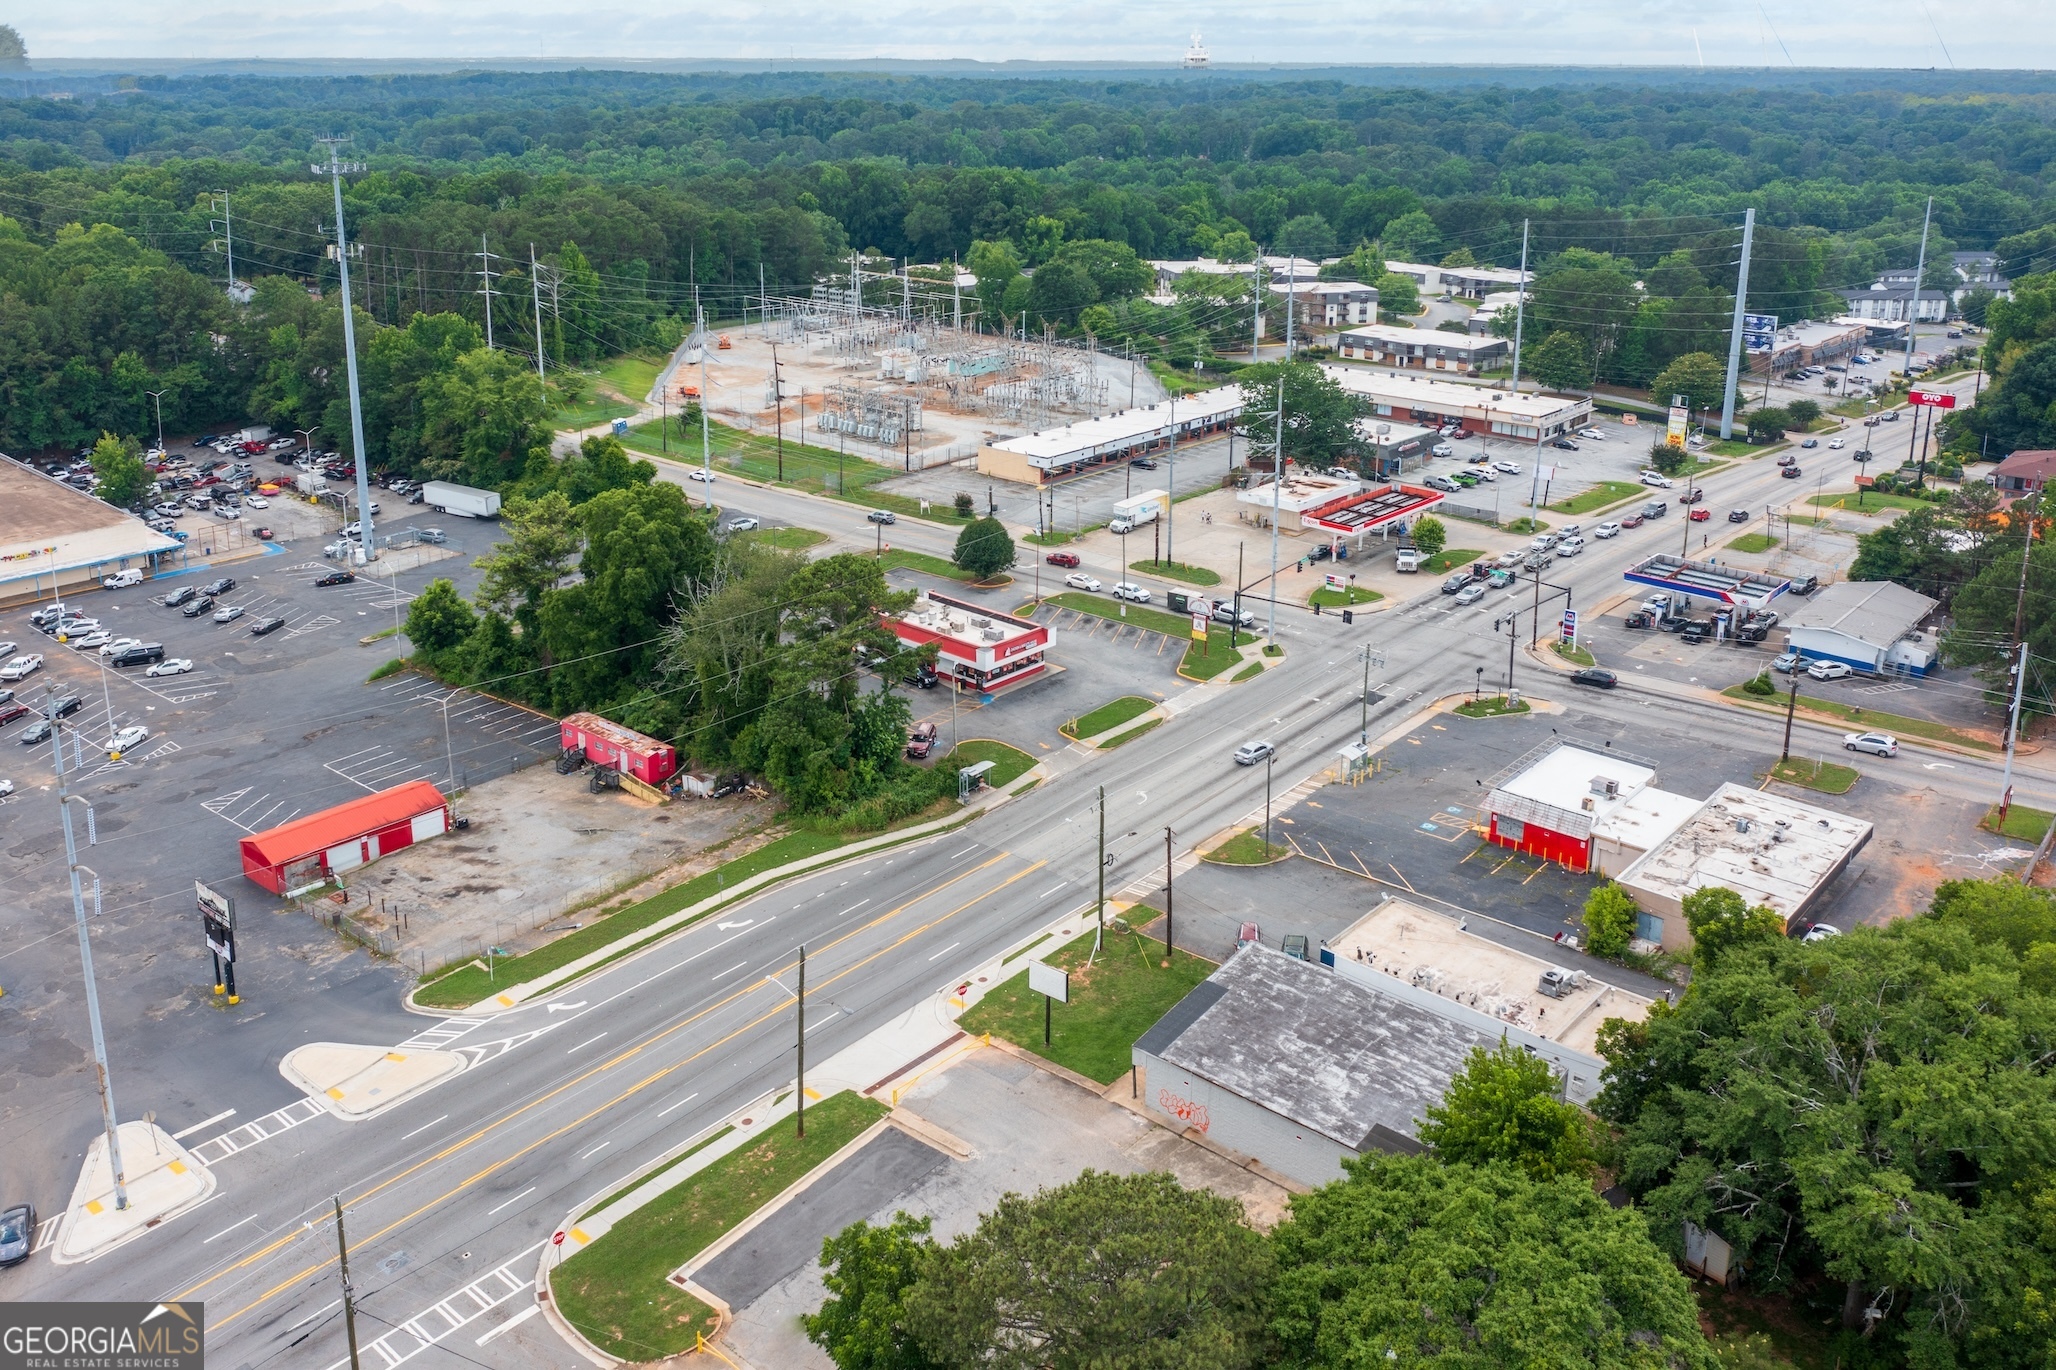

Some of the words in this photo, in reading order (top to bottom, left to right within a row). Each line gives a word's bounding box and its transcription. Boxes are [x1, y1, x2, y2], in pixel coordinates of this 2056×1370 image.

[1921, 393, 1942, 402] OYO
[1303, 517, 1318, 526] Exxon
[553, 1233, 565, 1243] STOP
